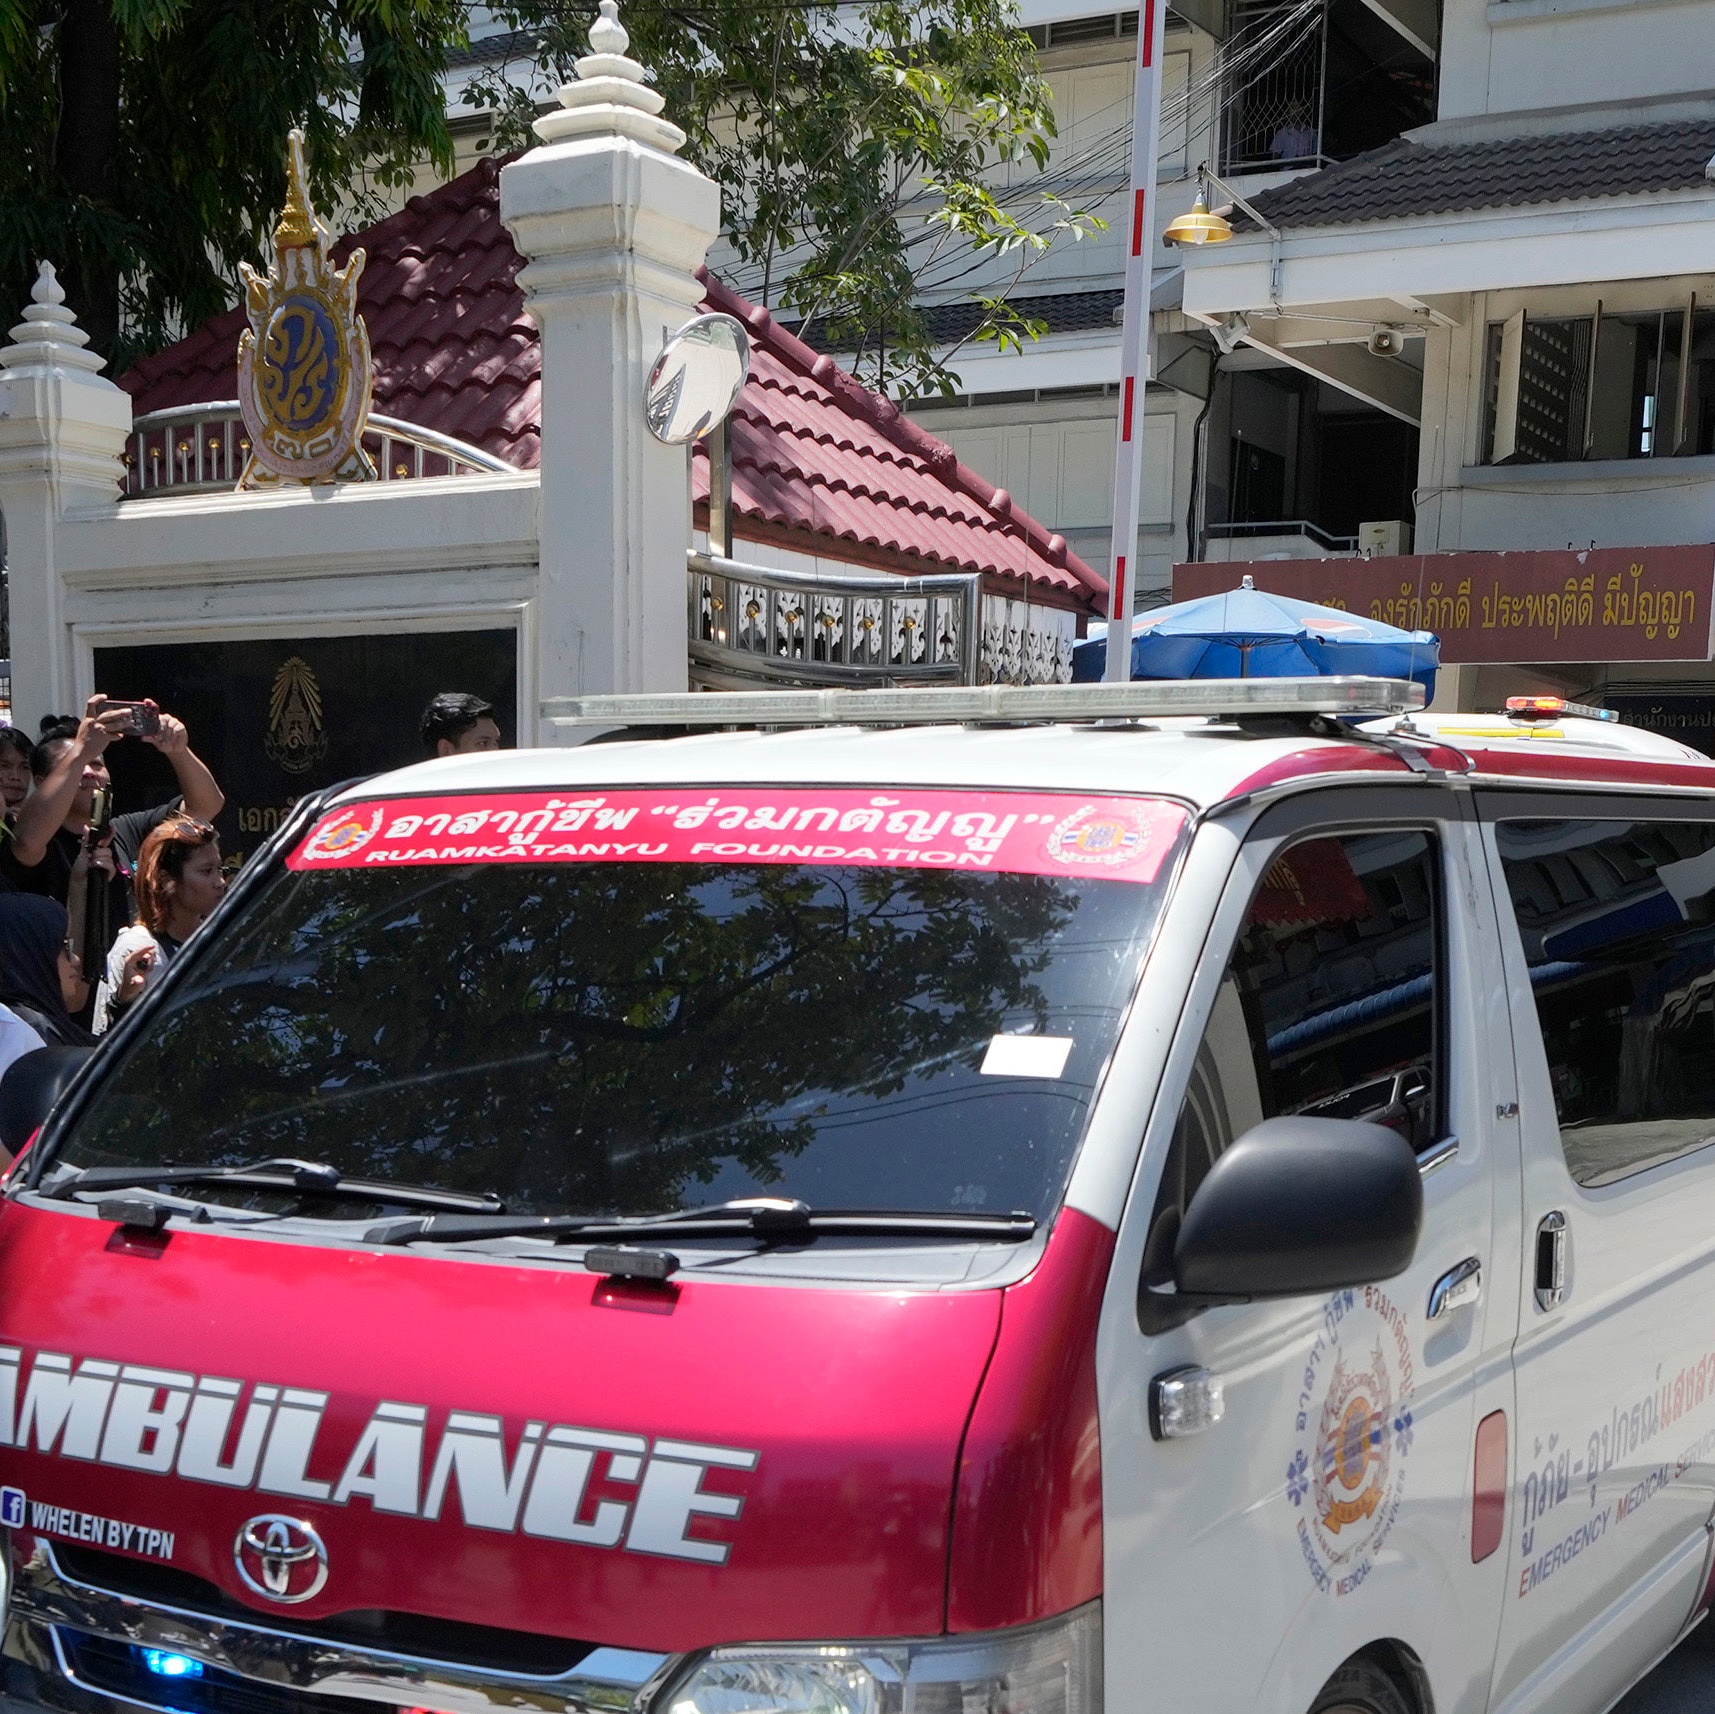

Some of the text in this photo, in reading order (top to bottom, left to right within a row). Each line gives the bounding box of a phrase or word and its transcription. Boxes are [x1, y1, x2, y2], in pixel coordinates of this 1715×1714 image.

[1481, 574, 1595, 640] ประพฤติดี
[1602, 563, 1695, 640] มีปัญญา
[384, 798, 640, 846] อาสากู้ชีพ
[365, 842, 994, 867] RUAMKATANYU FOUNDATION
[31, 1501, 105, 1545] WHELEN
[107, 1520, 135, 1551] BY
[135, 1526, 175, 1561] TPN
[1519, 1508, 1611, 1598] EMERGENCY
[1615, 1463, 1670, 1524] MEDICAL
[1336, 1558, 1372, 1598] MEDICAL
